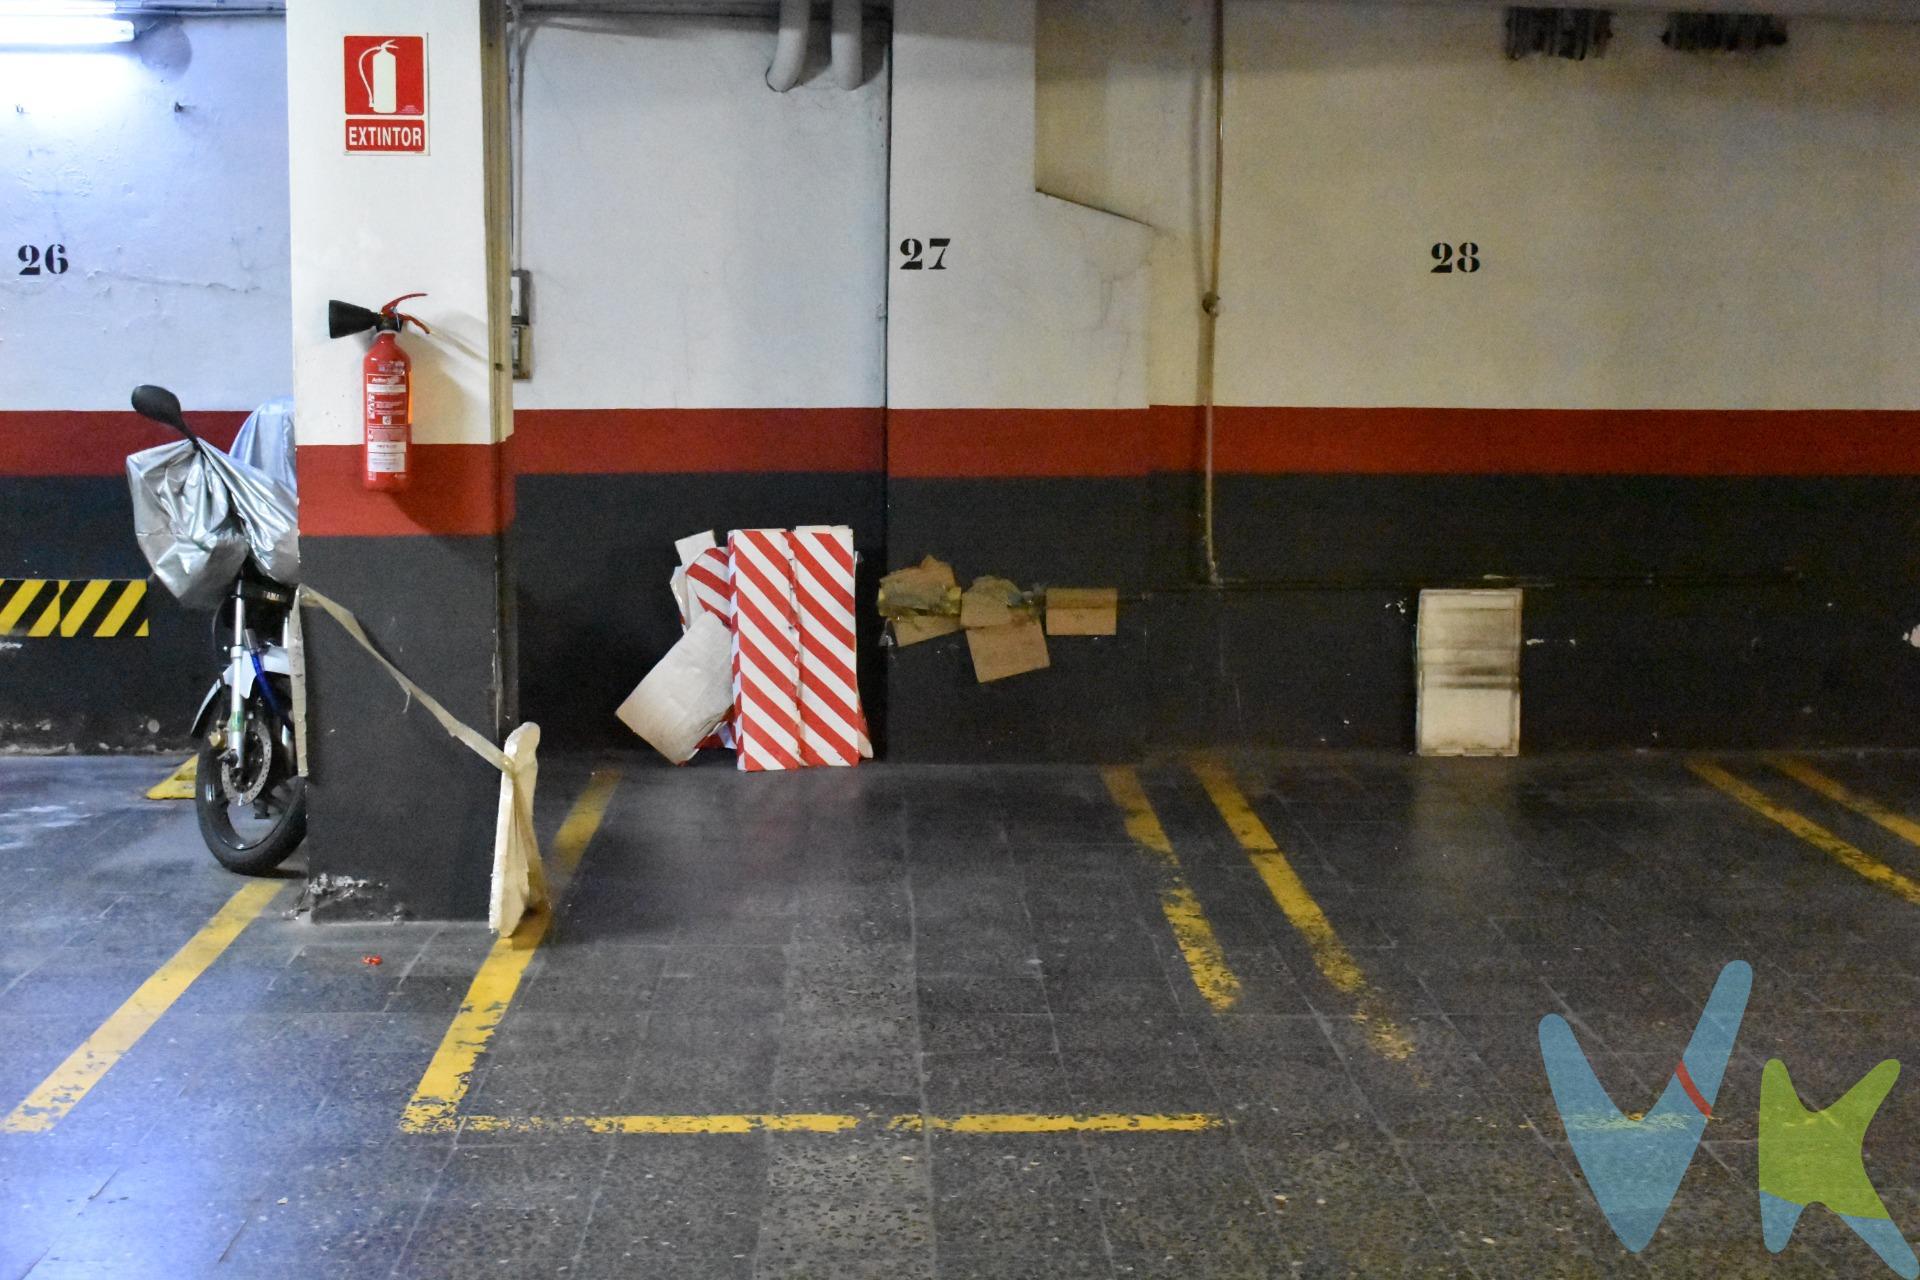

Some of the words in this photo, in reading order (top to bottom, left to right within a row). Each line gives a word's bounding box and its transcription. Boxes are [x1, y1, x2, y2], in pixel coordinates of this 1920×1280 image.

[348, 126, 422, 147] EXTINTOR
[17, 243, 69, 275] 26
[899, 237, 951, 270] 27
[1430, 242, 1480, 273] 28
